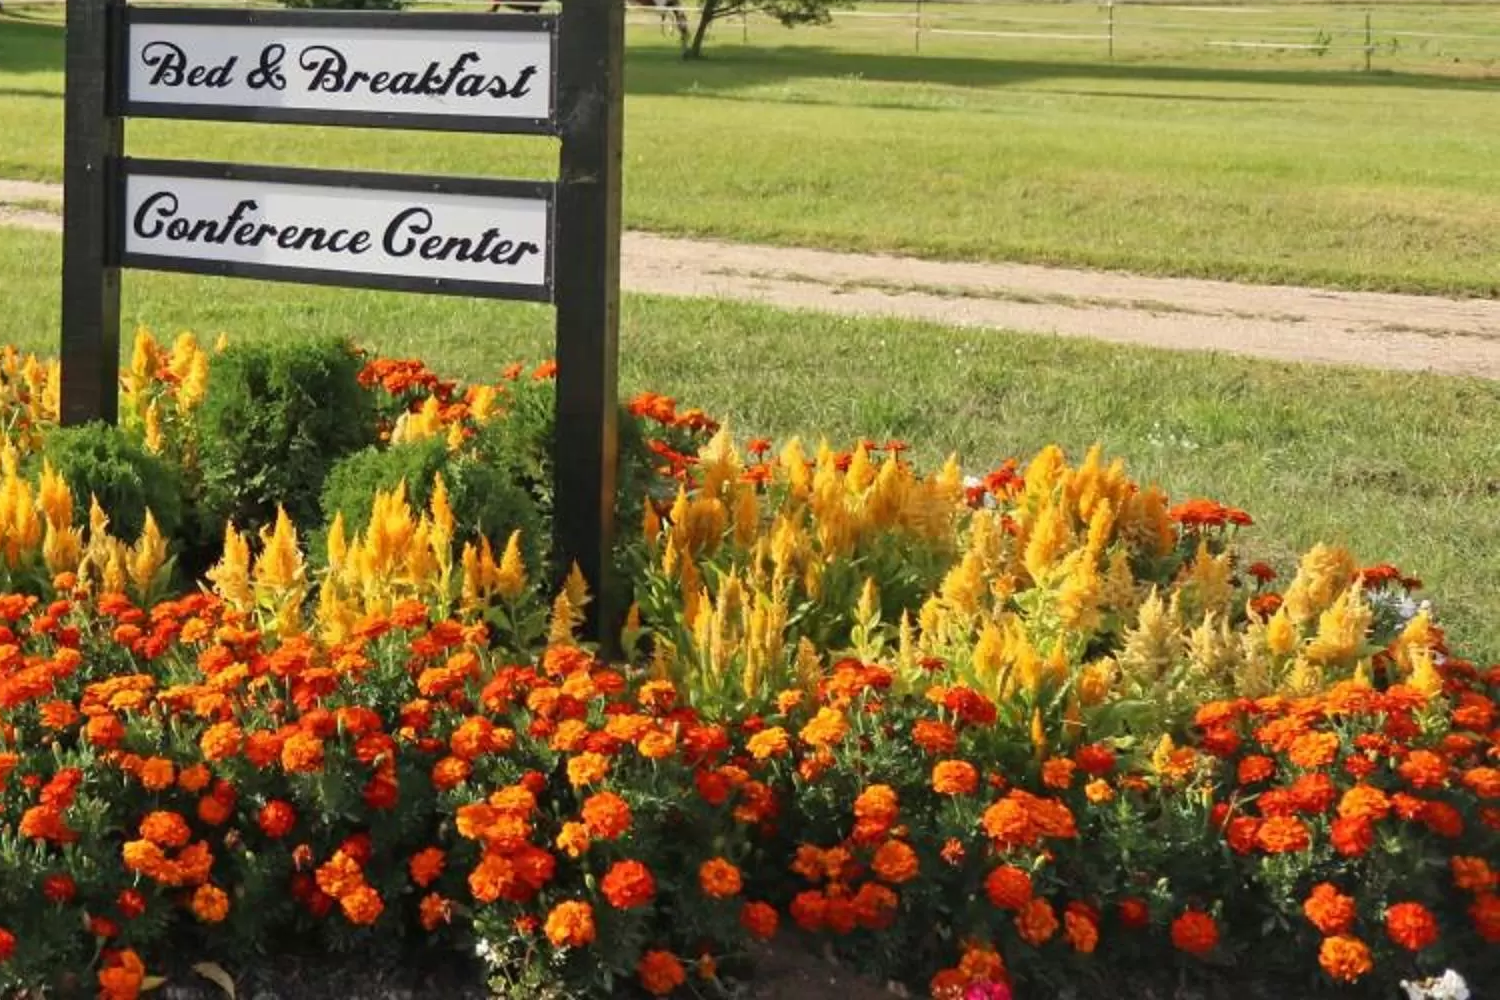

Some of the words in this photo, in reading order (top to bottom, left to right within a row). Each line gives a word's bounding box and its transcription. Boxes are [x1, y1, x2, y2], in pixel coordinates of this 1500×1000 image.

[141, 41, 239, 88] Bed
[246, 43, 287, 91] &
[299, 45, 538, 99] Breakfast
[133, 191, 373, 254] Conference
[382, 207, 540, 266] Center
